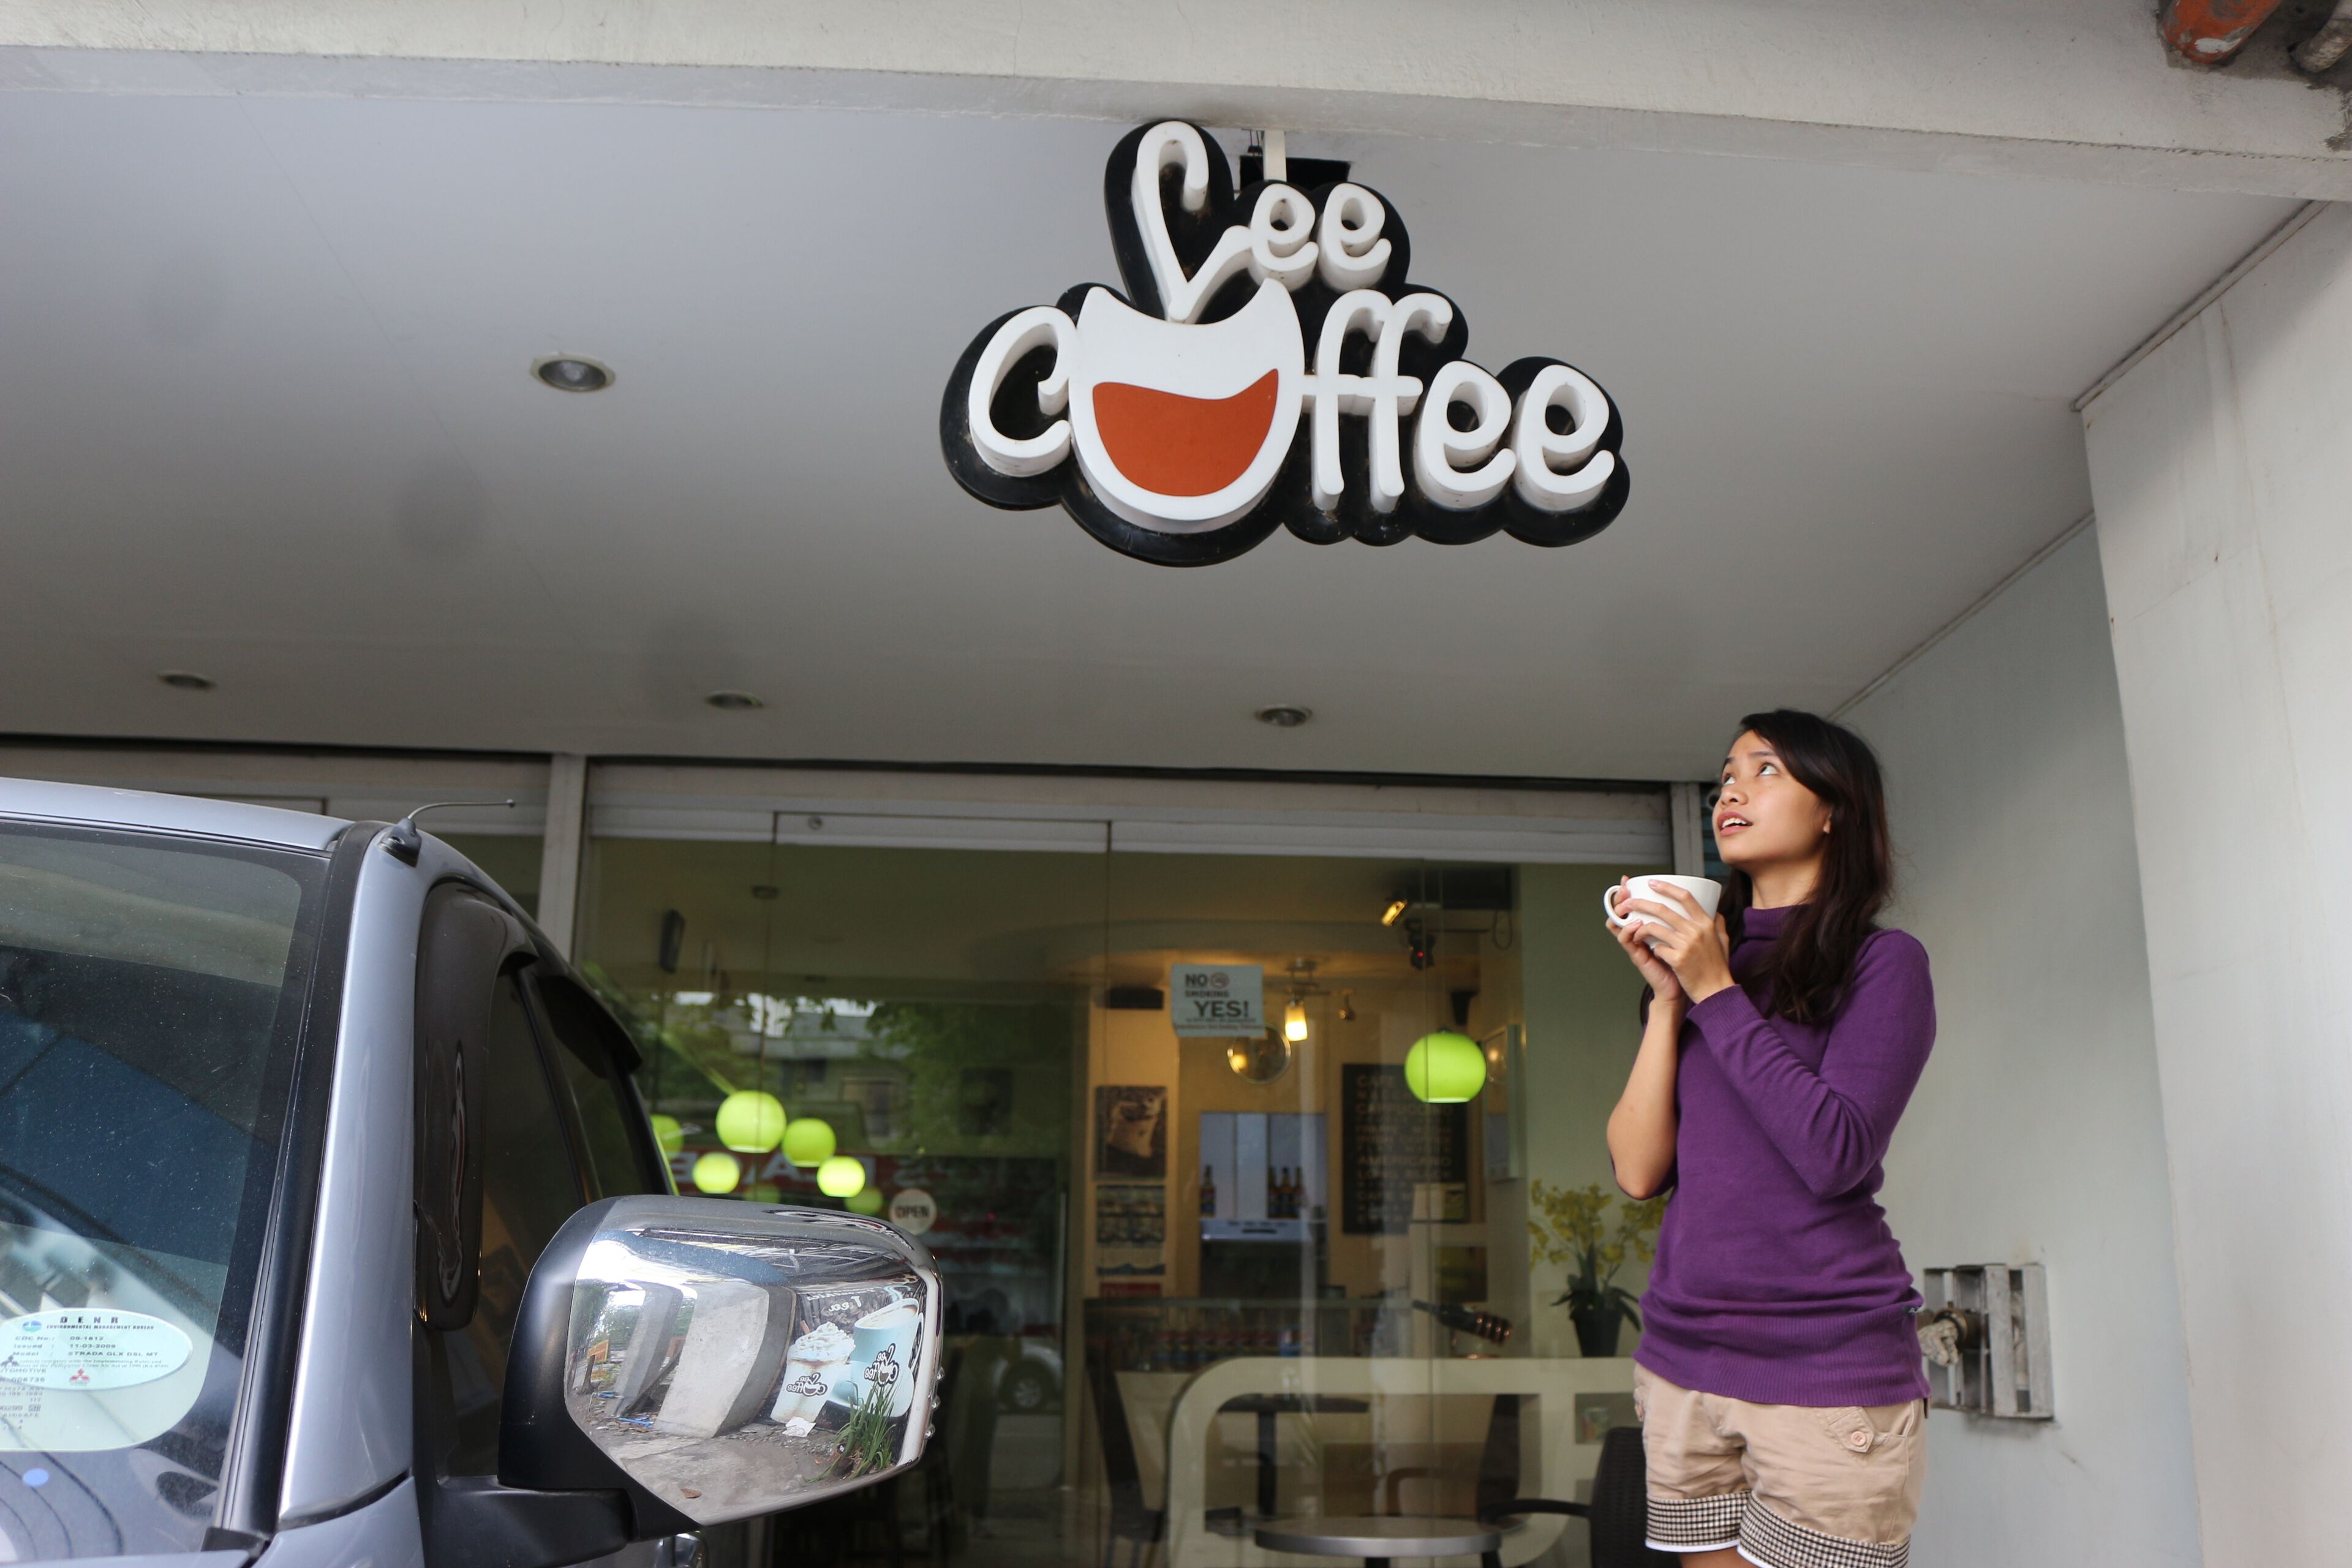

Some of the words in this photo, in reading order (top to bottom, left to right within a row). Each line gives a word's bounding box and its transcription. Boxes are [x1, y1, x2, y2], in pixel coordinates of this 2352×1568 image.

[1185, 973, 1207, 987] NO
[1194, 1000, 1249, 1017] YES!
[895, 1205, 930, 1218] OPEN
